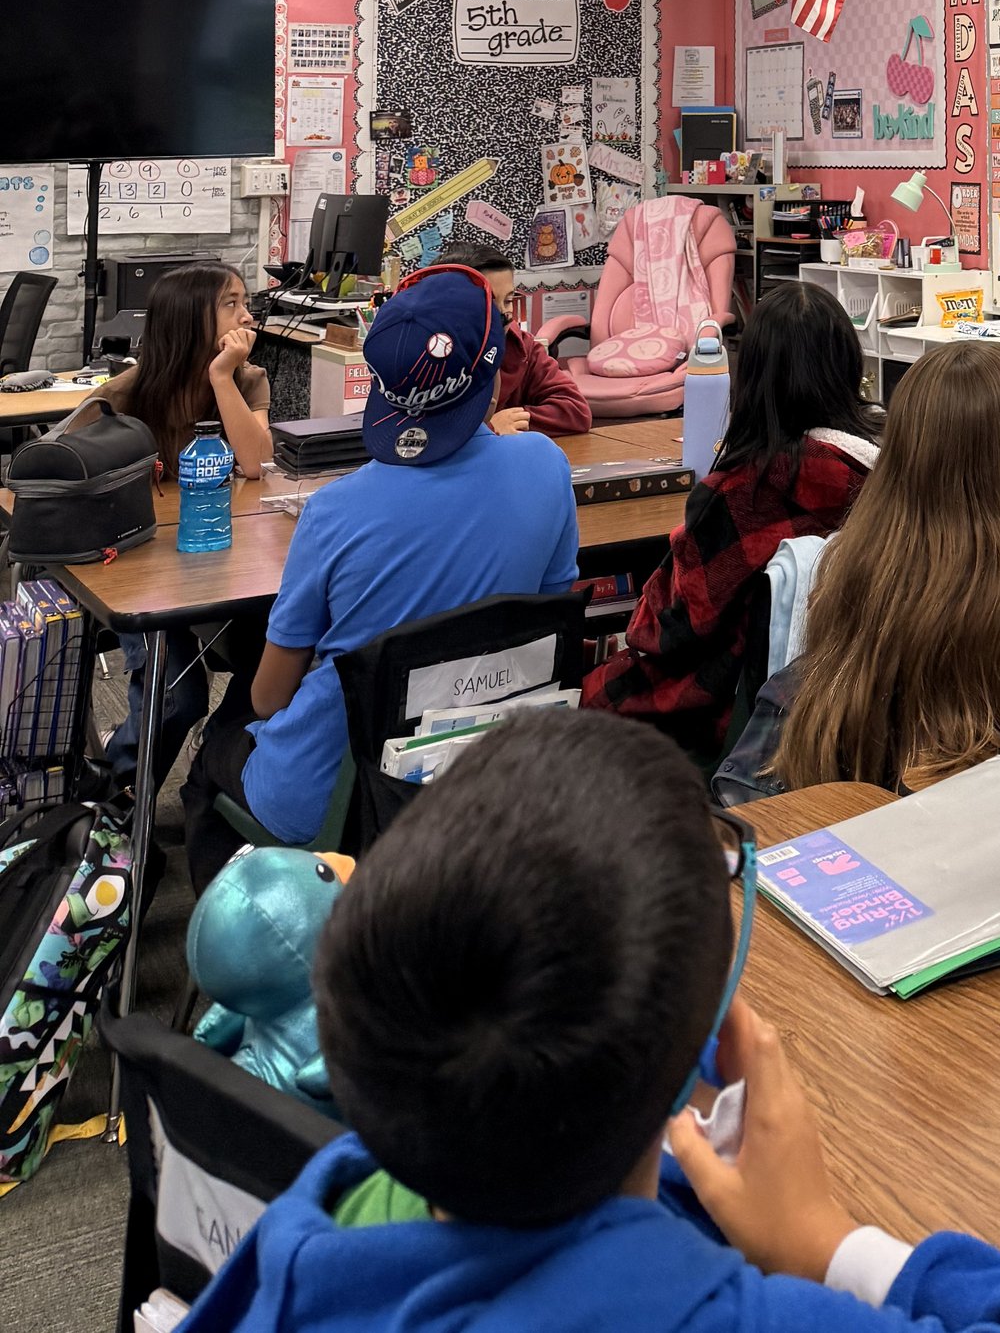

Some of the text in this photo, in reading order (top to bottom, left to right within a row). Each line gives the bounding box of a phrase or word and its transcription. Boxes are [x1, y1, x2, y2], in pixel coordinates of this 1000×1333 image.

[466, 0, 519, 32] 5th
[488, 18, 563, 57] grade
[896, 102, 935, 140] kind
[195, 467, 220, 478] ADE
[196, 454, 234, 468] POWER
[453, 668, 513, 697] SAMUEL
[831, 889, 903, 921] Binder
[832, 898, 914, 931] D-Ring
